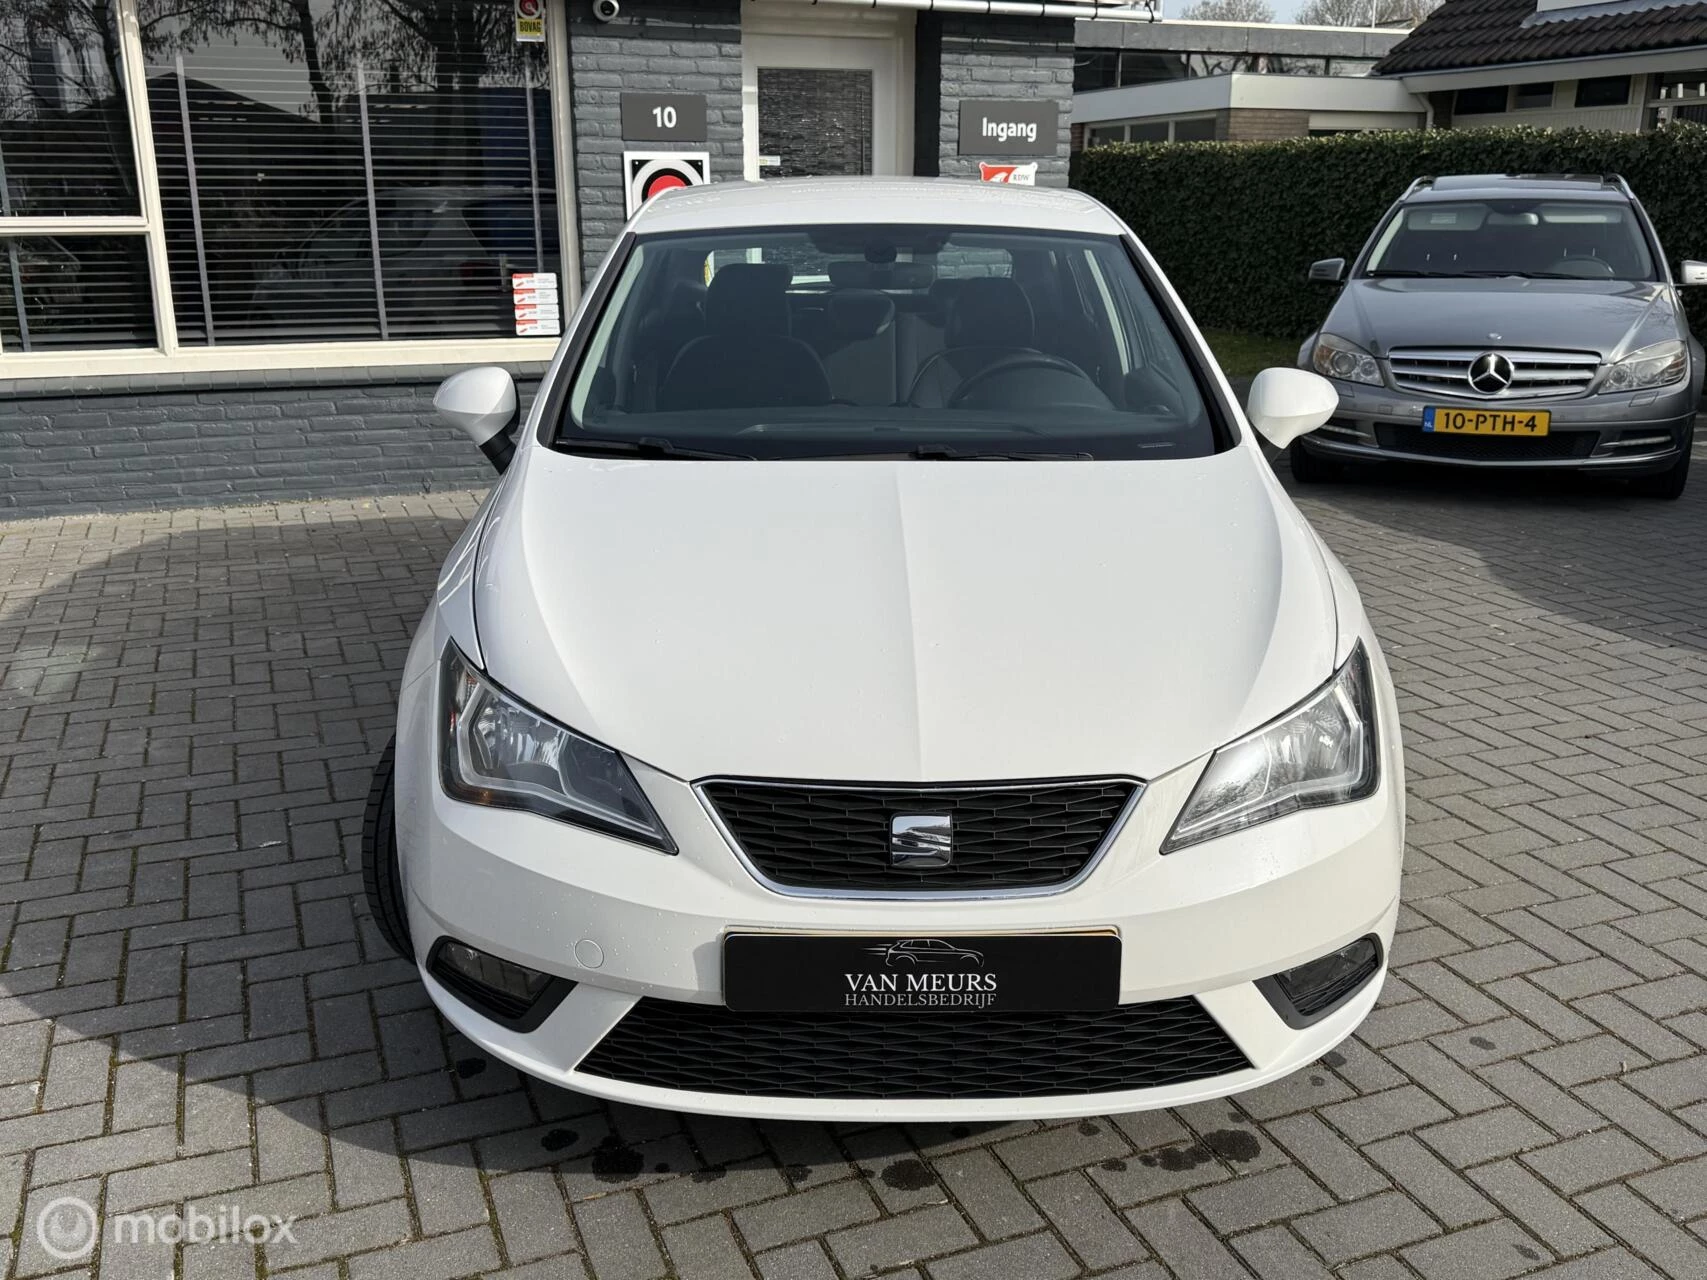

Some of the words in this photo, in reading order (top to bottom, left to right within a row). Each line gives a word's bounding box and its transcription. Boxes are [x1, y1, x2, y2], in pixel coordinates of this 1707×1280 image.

[520, 21, 542, 32] BOVAG
[652, 106, 677, 128] 10
[982, 117, 1037, 142] Ingang
[1444, 412, 1537, 432] 10-PTH-4
[844, 972, 898, 992] VAN
[906, 972, 997, 992] MEURS
[844, 993, 997, 1009] HANDELSBEDRIJF
